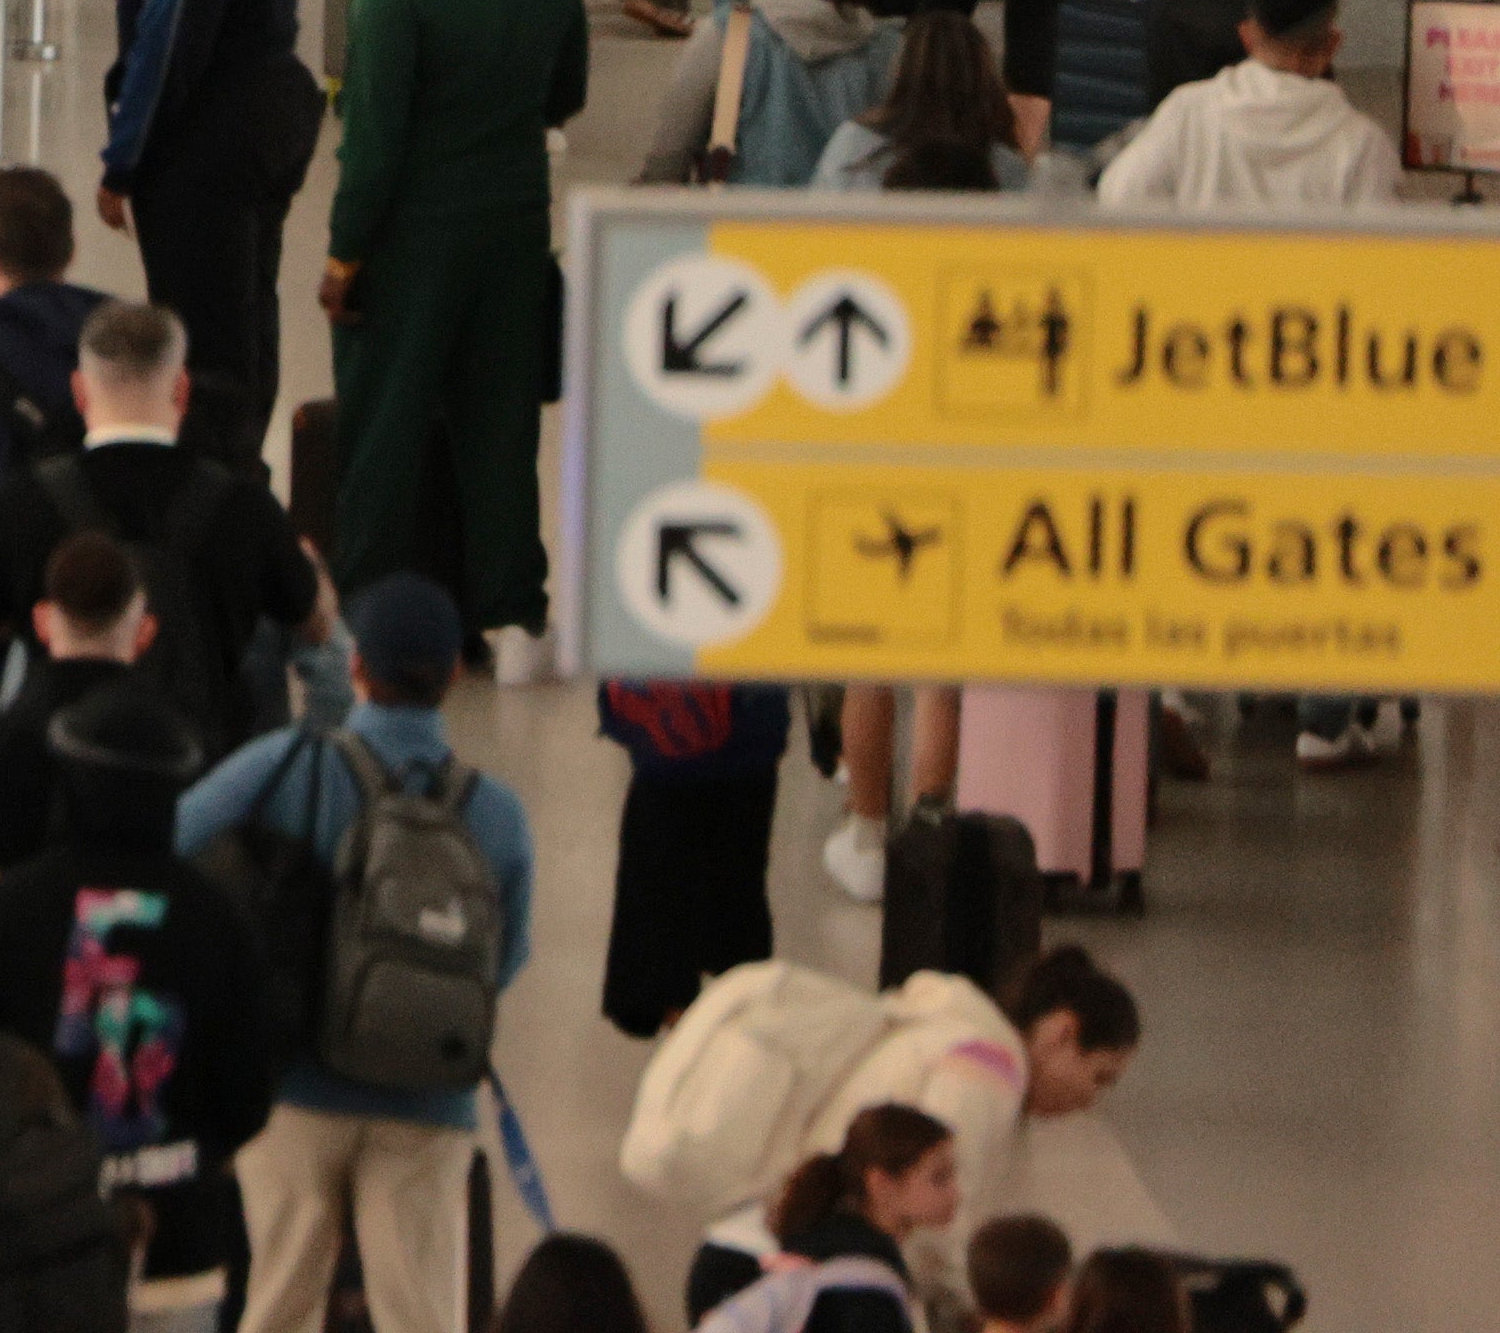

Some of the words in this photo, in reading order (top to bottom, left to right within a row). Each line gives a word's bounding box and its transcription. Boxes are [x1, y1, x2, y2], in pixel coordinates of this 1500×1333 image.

[1117, 303, 1482, 393] JetBlue
[1000, 499, 1138, 580] All
[1184, 501, 1482, 589] Gates
